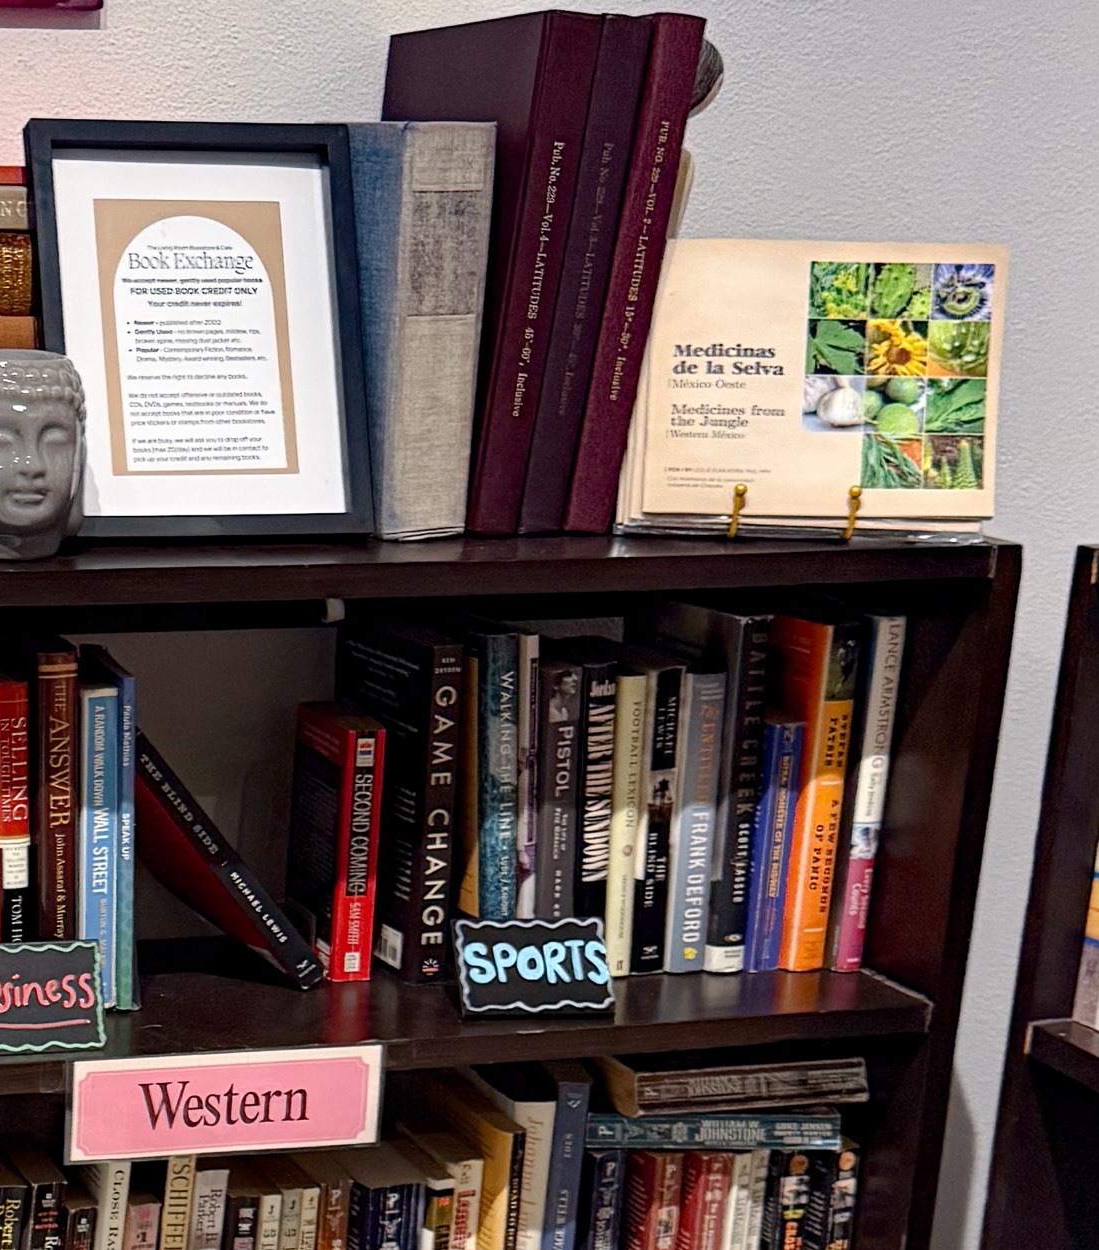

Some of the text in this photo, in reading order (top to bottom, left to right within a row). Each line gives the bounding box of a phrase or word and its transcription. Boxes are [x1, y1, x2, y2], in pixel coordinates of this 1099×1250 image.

[128, 252, 254, 274] Book Exchange
[130, 287, 258, 295] FOR USED BOOK CREDIT ONLY
[672, 361, 785, 376] de la Selva
[673, 344, 776, 359] Medicinas
[672, 378, 747, 389] México Oeste
[670, 429, 745, 440] Western México
[671, 404, 786, 417] Medicines from
[671, 416, 749, 429] the Jungle
[11, 717, 28, 823] SELLING
[49, 719, 72, 829] ANSWER
[554, 725, 575, 799] PISTOL
[121, 812, 131, 861] SPEAK UP
[348, 773, 374, 895] SECOND COMING
[420, 685, 458, 945] GAME CHANGE
[91, 806, 109, 895] WALL STREET
[139, 754, 289, 944] THE BLIND SIDE MICHAEL LEWIS
[681, 811, 709, 944] FRANK DEFORD
[463, 941, 610, 985] SPORTS
[138, 1080, 310, 1131] Western
